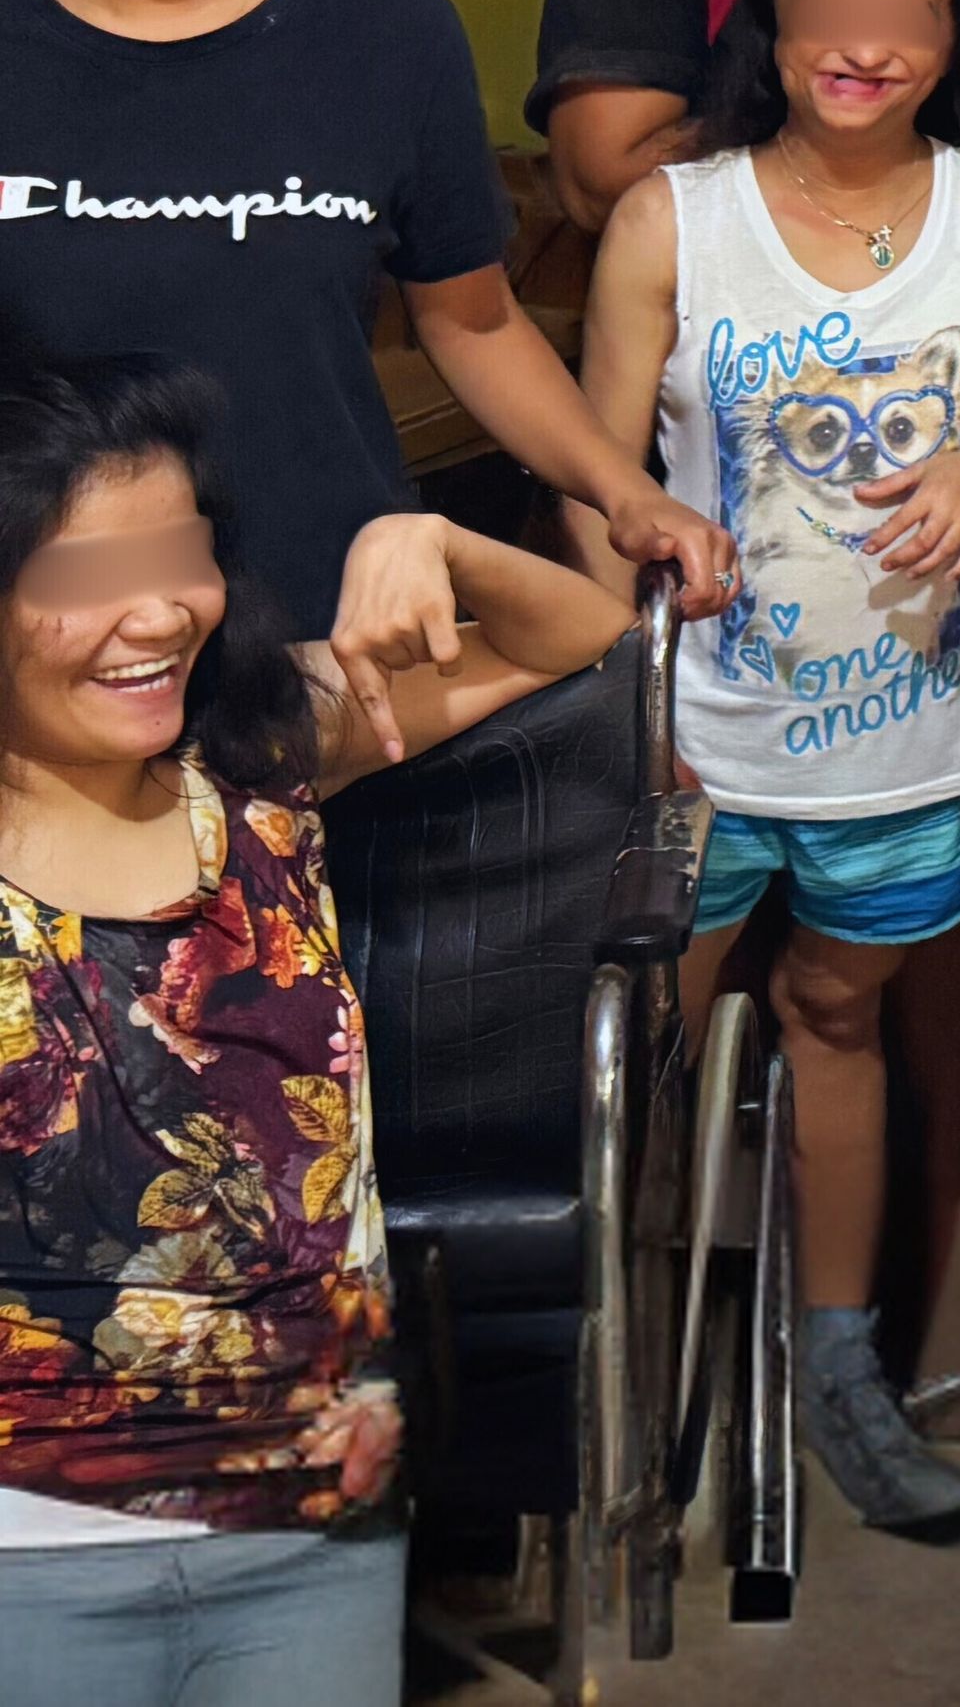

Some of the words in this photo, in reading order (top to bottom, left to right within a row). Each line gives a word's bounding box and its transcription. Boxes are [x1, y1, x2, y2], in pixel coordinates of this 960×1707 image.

[0, 176, 378, 242] Champion
[706, 310, 861, 413] love
[792, 631, 907, 704] one
